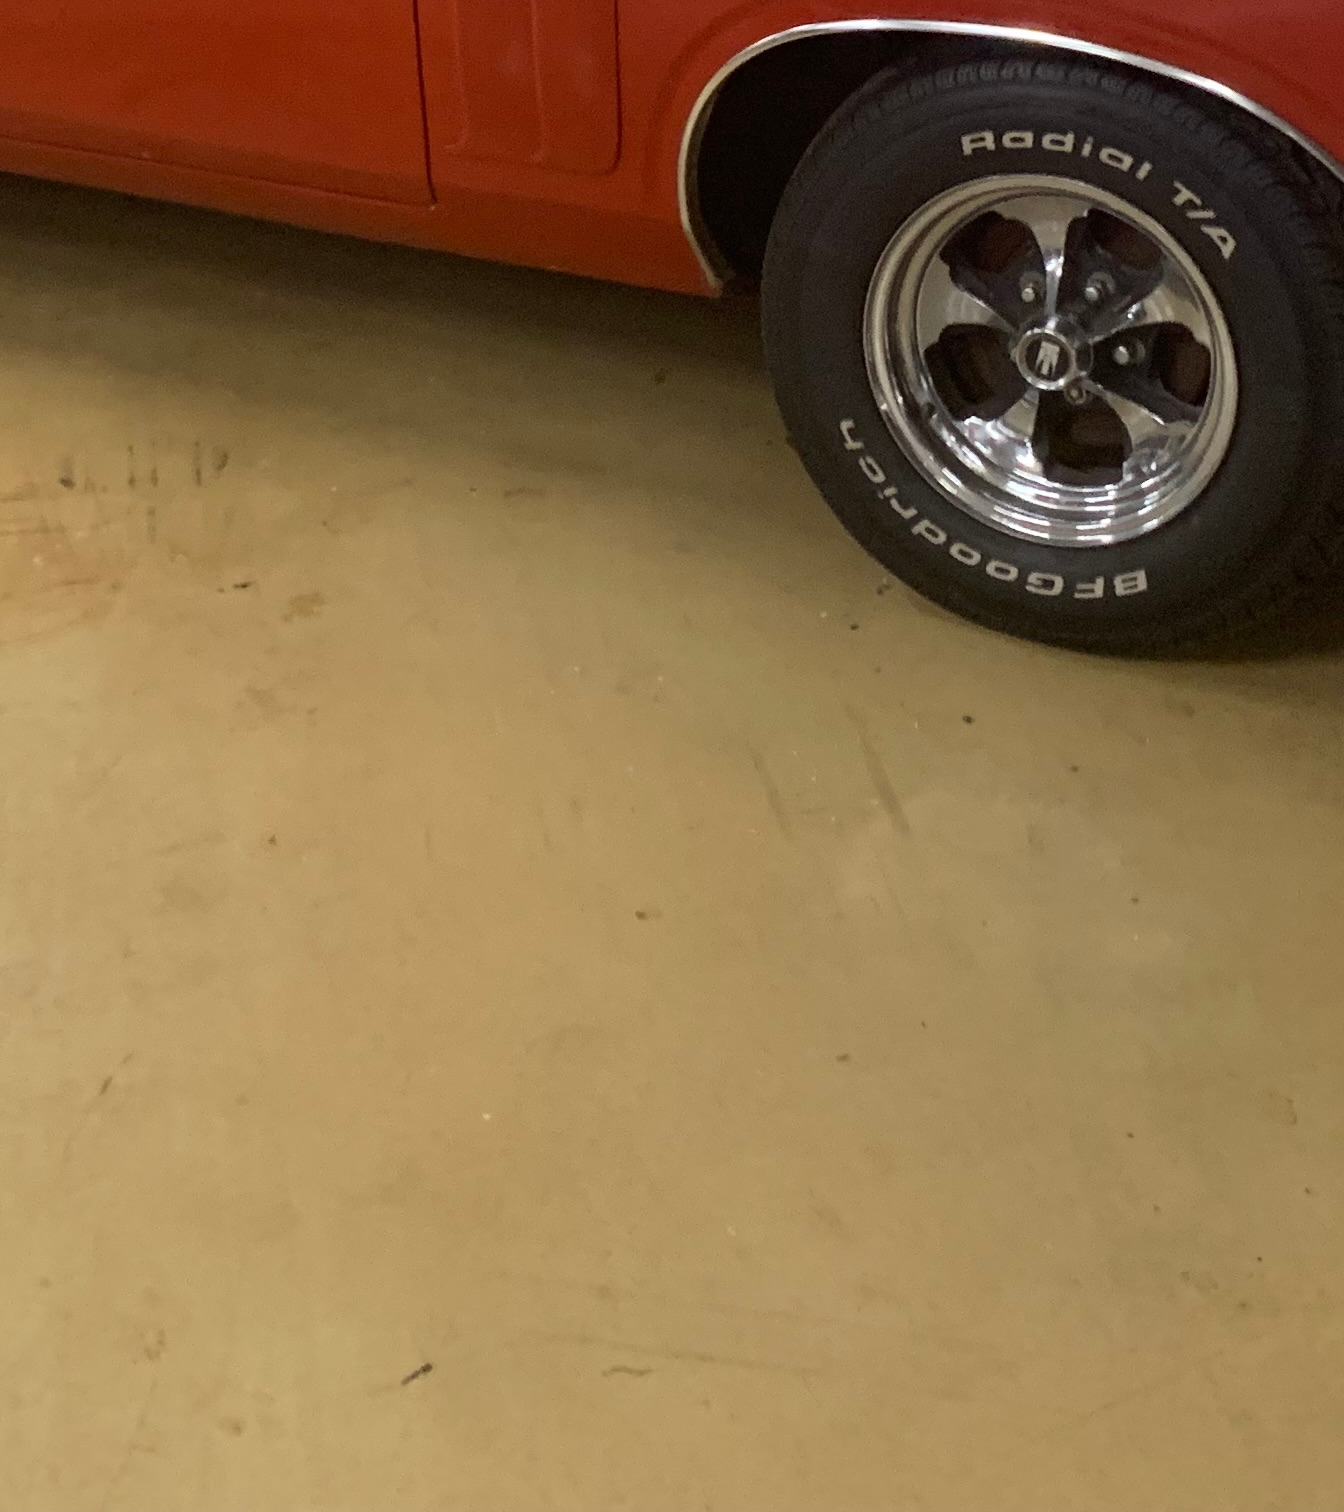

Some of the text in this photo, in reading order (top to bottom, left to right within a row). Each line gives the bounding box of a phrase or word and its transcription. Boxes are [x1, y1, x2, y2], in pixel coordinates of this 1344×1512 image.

[961, 130, 1238, 261] Radial T/A
[839, 418, 1148, 600] BFGoodrich
